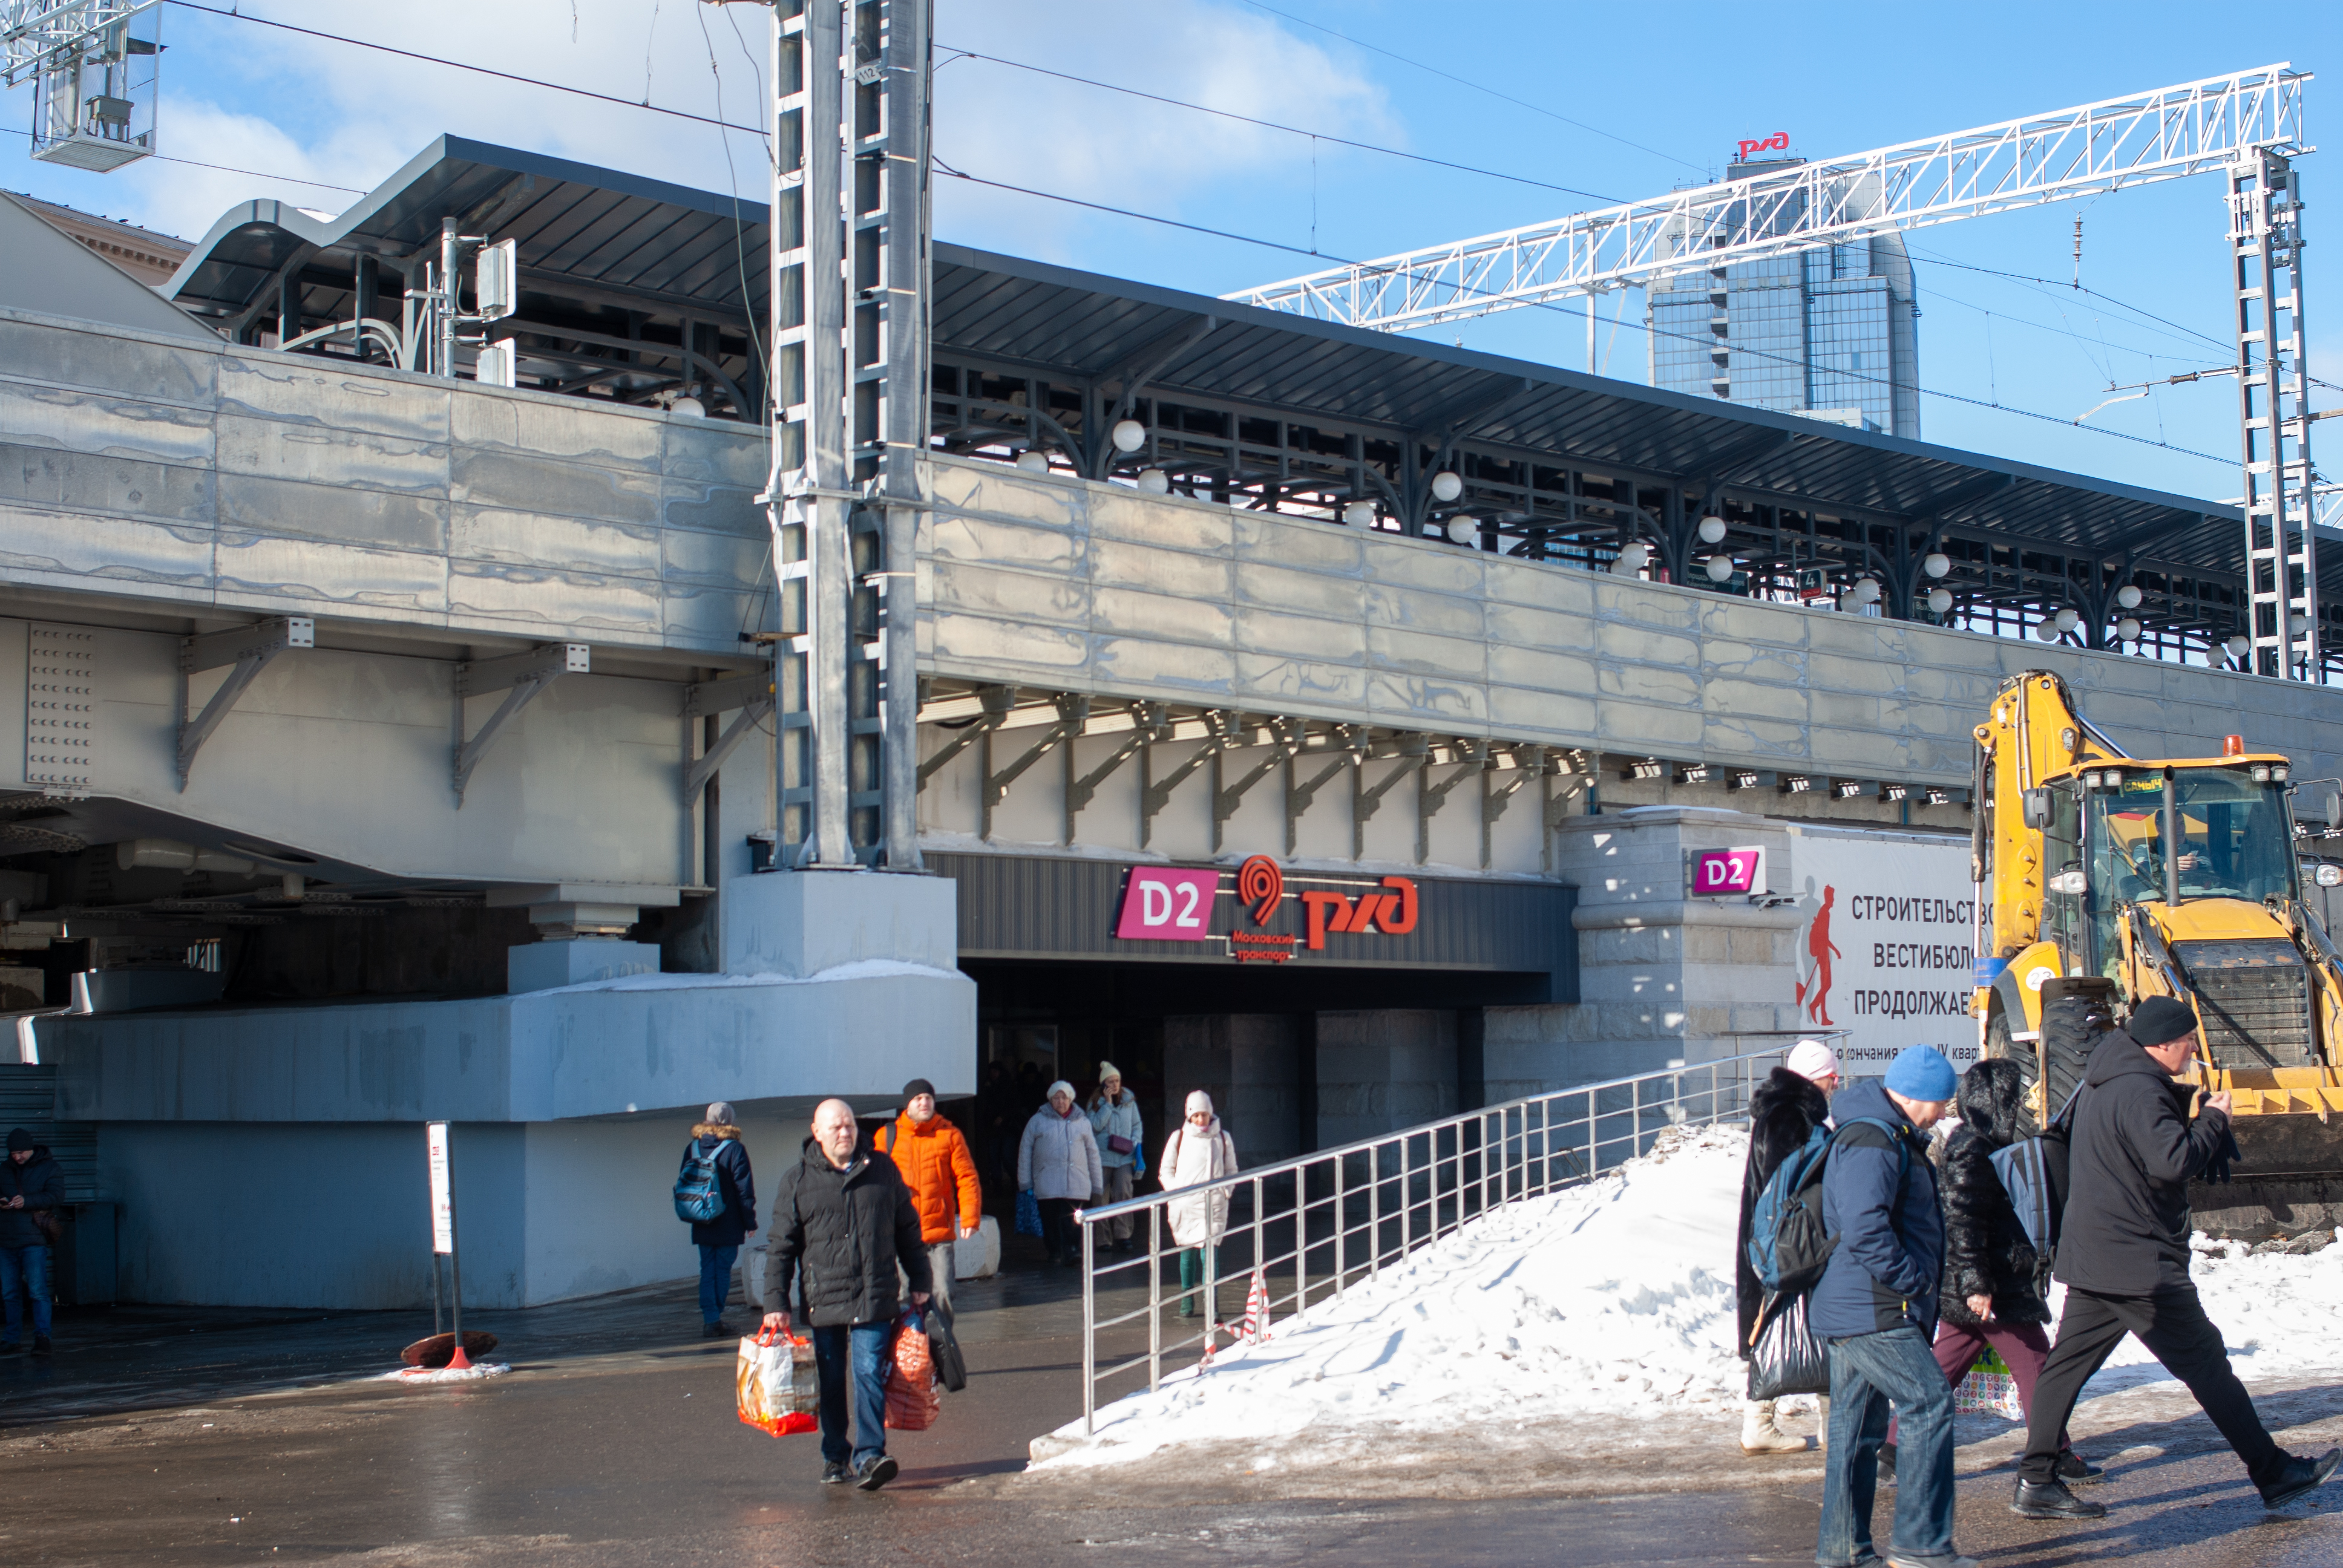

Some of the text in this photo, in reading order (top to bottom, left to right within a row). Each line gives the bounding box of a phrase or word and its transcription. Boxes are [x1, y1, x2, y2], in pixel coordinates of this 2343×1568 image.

[859, 68, 876, 80] 112
[1806, 573, 1815, 587] 4
[1705, 858, 1744, 886] D2
[1138, 880, 1200, 927] D2
[1233, 929, 1295, 944] Московский
[1237, 950, 1291, 964] транспорт
[1855, 990, 1973, 1019] ПРОДОЛЖАЕ
